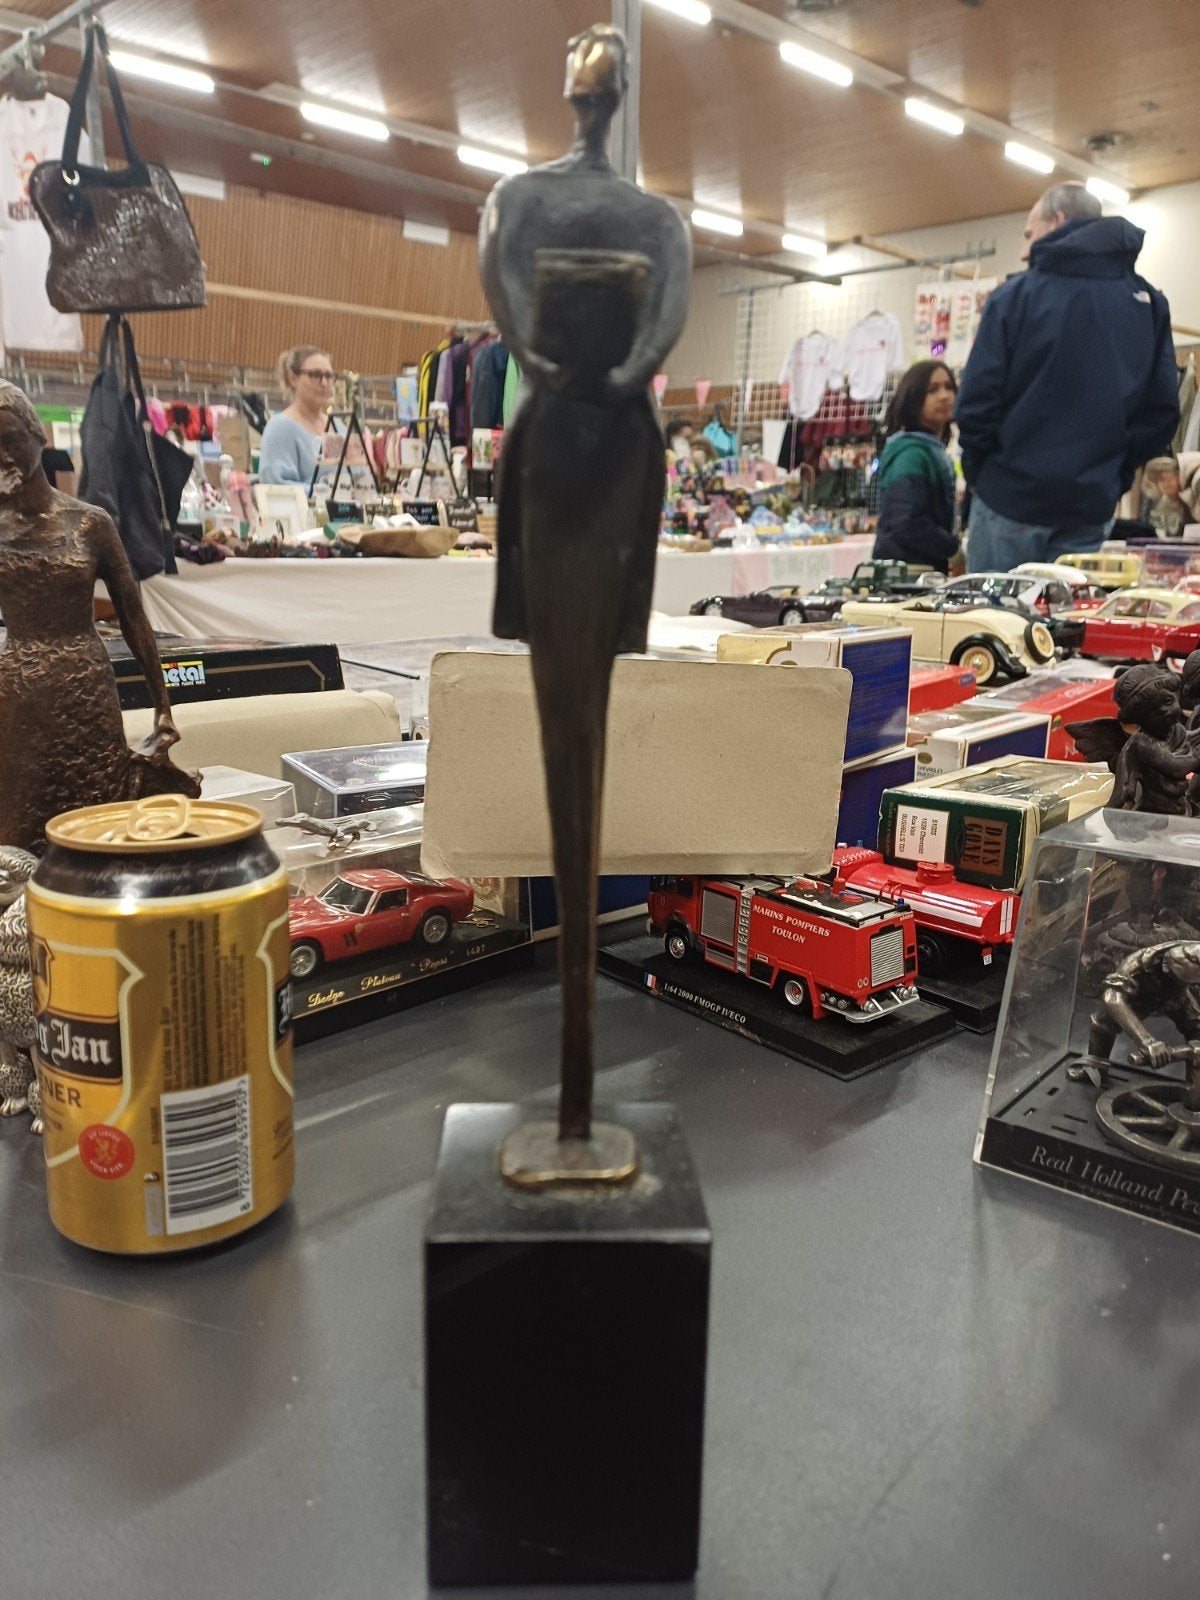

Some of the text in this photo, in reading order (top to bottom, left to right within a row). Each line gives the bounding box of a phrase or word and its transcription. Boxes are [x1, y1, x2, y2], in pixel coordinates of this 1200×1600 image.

[918, 831, 926, 855] Chevrolet
[962, 823, 983, 863] GONE
[981, 826, 1003, 866] DAYS
[752, 904, 831, 937] MARINS POMPIERS
[771, 925, 806, 944] TOULON
[307, 989, 345, 1008] Dodge
[360, 972, 402, 991] Plateau
[664, 982, 746, 1024] 1:64 2000 FMOGP IVECO
[50, 1018, 112, 1066] Jan
[1030, 1144, 1075, 1175] Real
[1080, 1160, 1164, 1202] Holland
